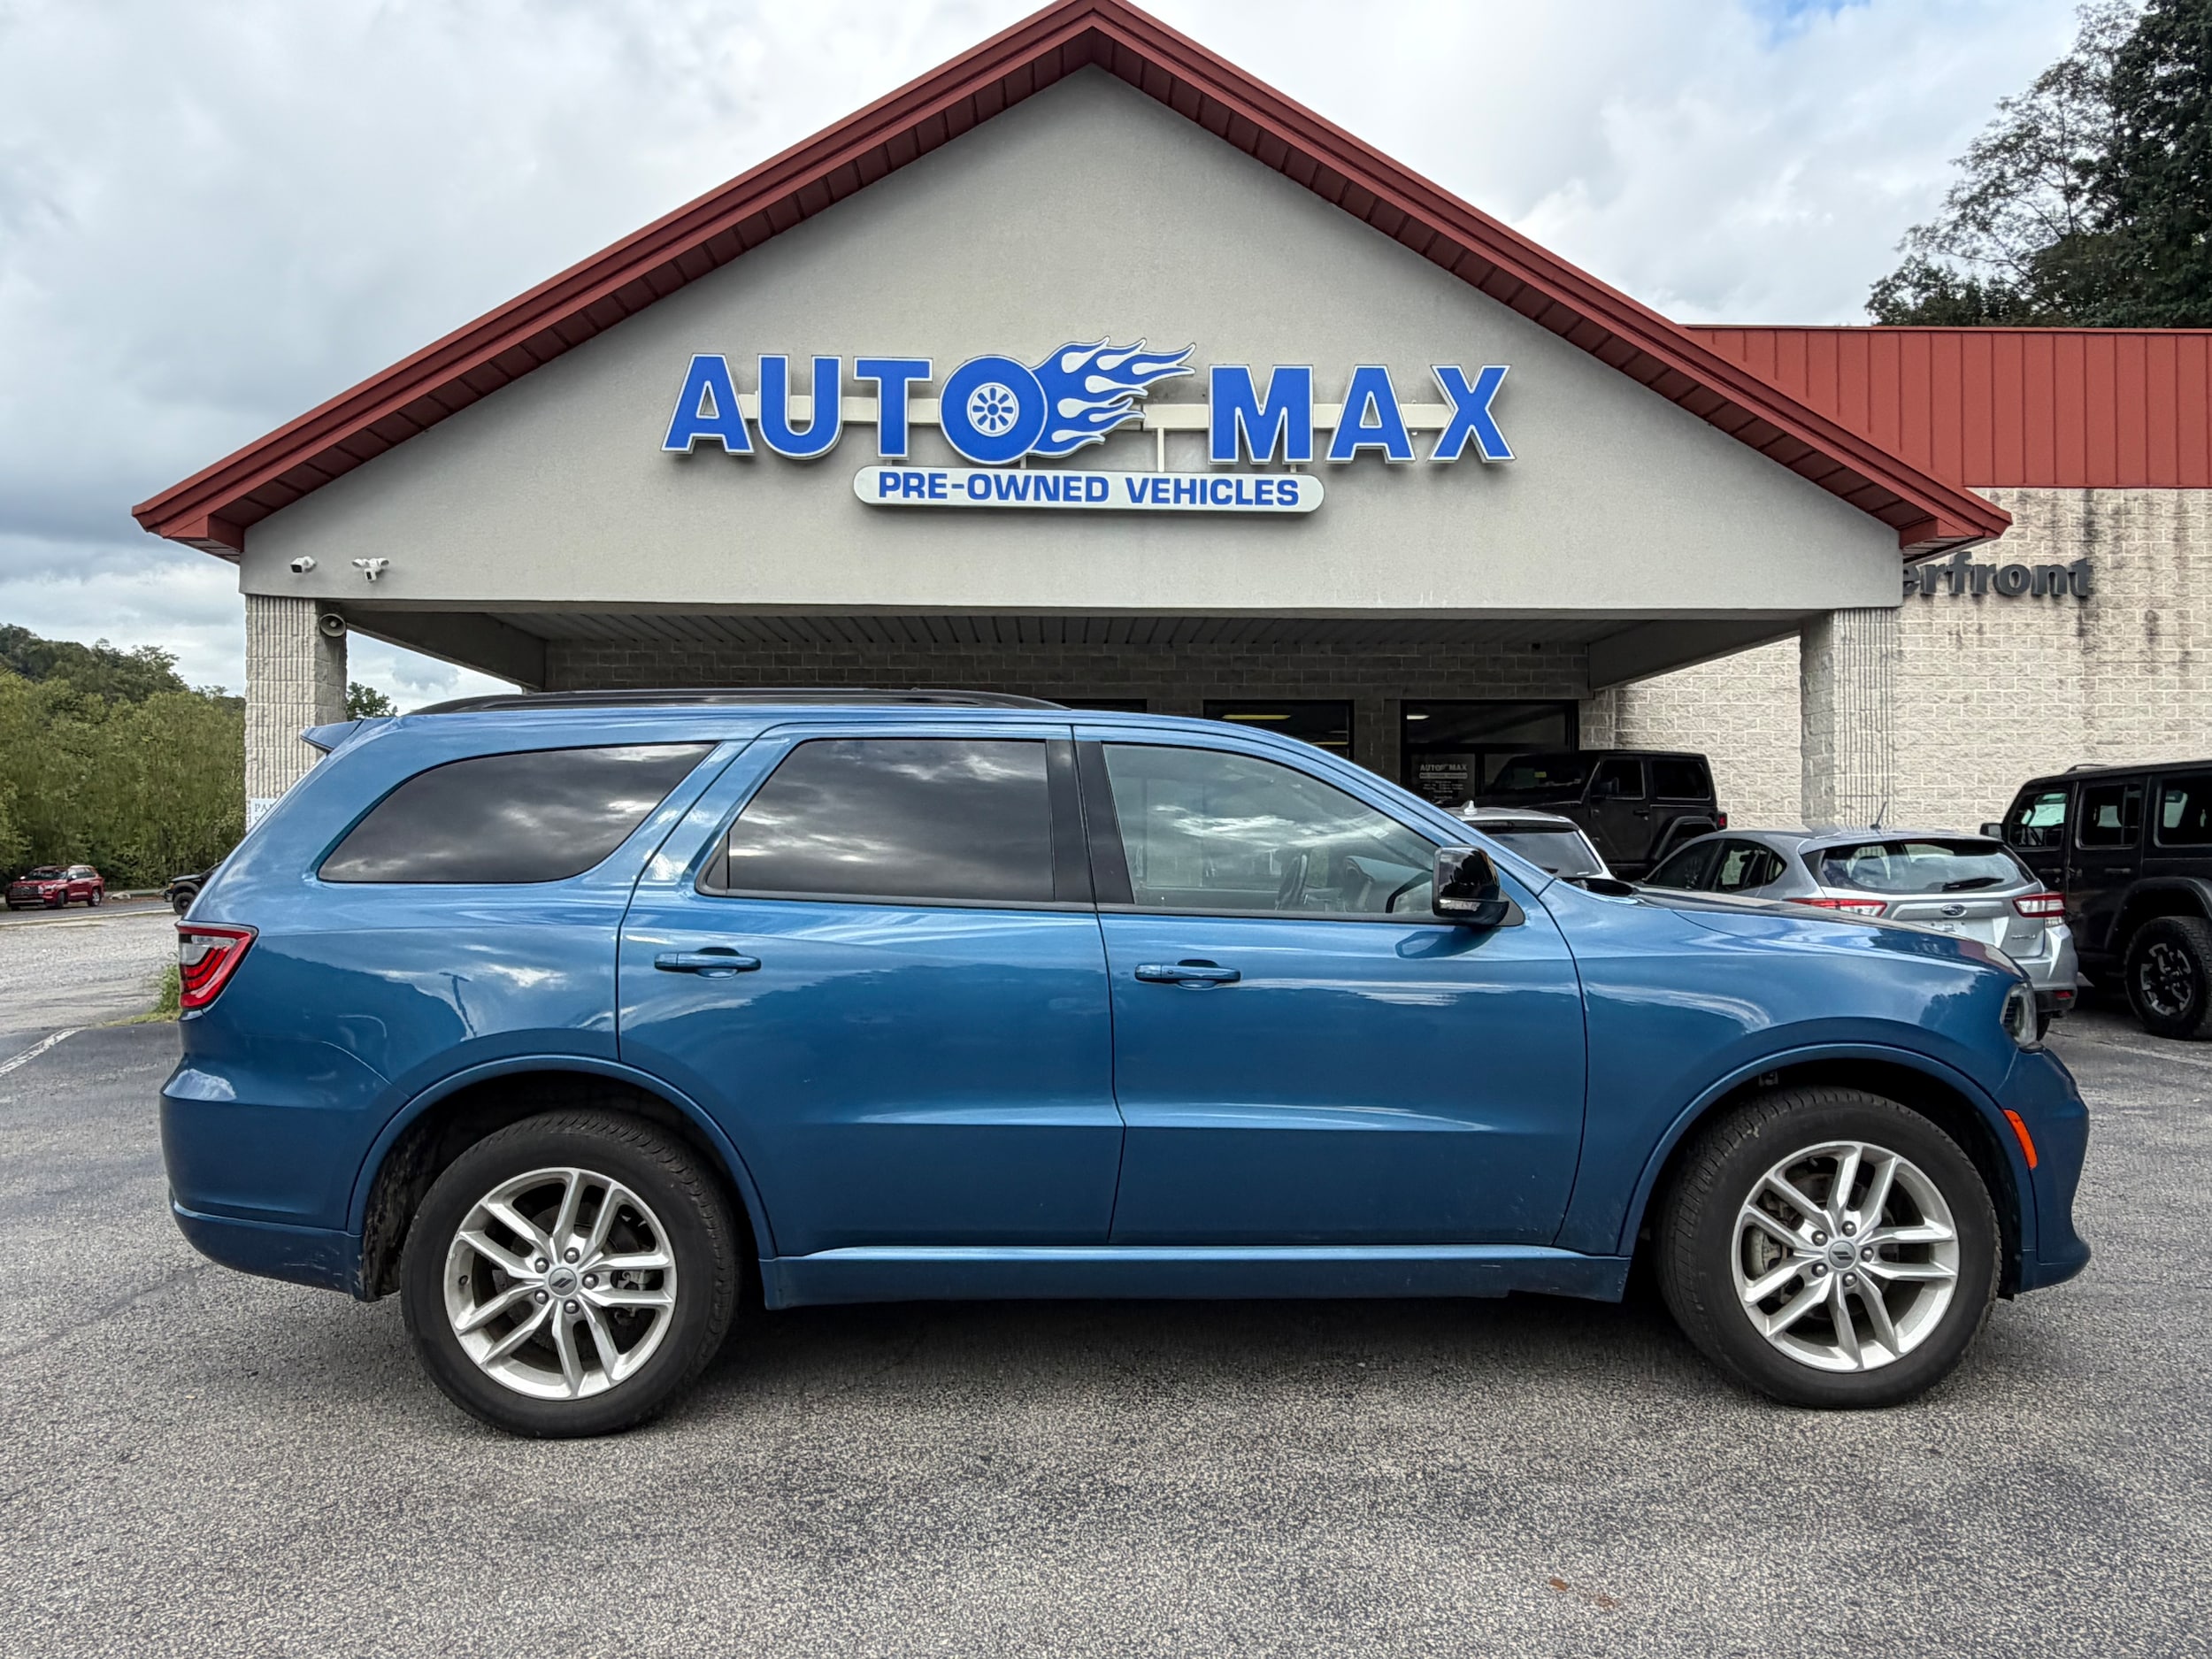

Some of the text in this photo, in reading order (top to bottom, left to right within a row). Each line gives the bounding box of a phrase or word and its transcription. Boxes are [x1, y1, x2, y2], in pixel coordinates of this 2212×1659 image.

[660, 353, 1516, 465] AUTO MAX
[879, 472, 1299, 506] PRE-OWNED VEHICLES
